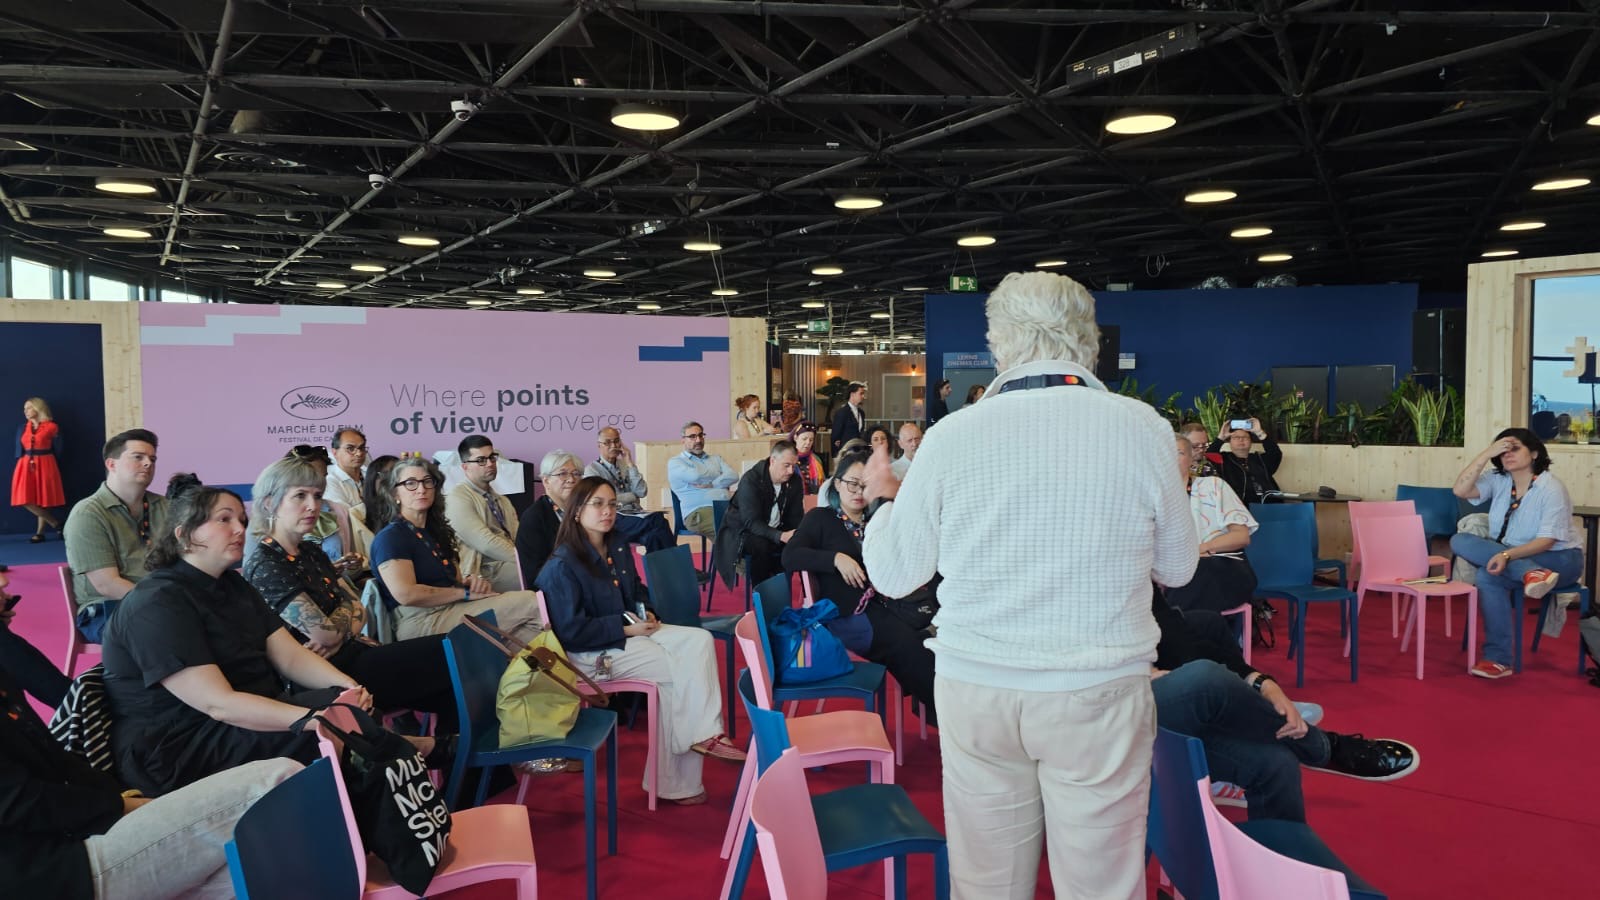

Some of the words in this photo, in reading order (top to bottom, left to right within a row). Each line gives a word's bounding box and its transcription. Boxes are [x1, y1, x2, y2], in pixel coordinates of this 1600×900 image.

[389, 383, 486, 408] Where
[497, 383, 590, 412] points
[267, 423, 316, 434] MARCHÉ
[320, 424, 335, 433] DU
[390, 411, 423, 435] of
[430, 410, 504, 434] view
[514, 414, 636, 434] converge
